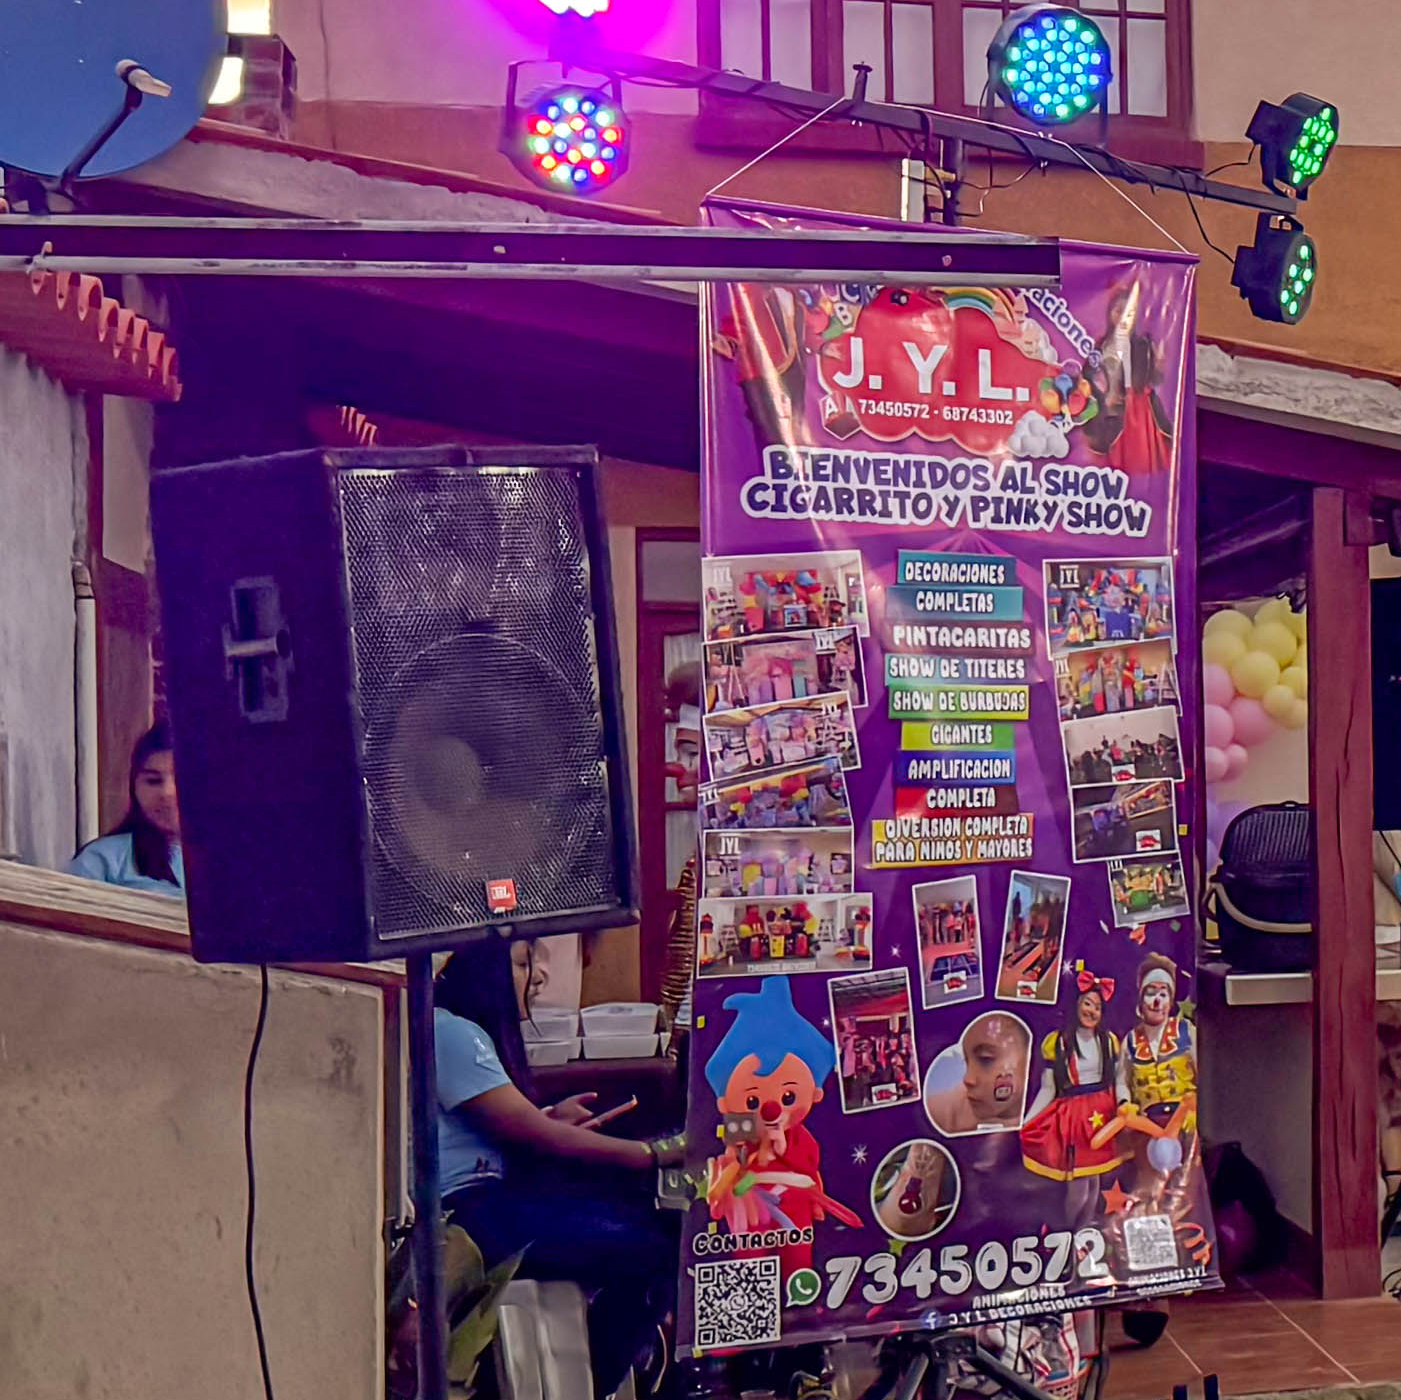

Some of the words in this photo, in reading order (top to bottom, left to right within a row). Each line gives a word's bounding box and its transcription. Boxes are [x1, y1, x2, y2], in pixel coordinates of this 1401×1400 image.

[833, 337, 882, 389] J.
[903, 341, 956, 396] Y.
[978, 348, 1030, 402] L.
[858, 399, 930, 418] 73450572
[942, 406, 1013, 424] 68743302
[769, 450, 990, 492] BIENVENIDOS
[1000, 465, 1037, 495] AL
[1044, 468, 1124, 500] SHOW
[746, 482, 934, 518] CIGARRITO
[942, 495, 963, 519] Y
[971, 495, 1060, 526] PINKY
[1067, 501, 1147, 532] SHOW
[905, 561, 1005, 584] DECORACIONES
[915, 591, 994, 613] COMPLETAS
[893, 625, 1031, 648] PINTACARITAS
[889, 657, 935, 678] SHOW
[940, 658, 960, 678] DE
[965, 658, 1025, 679] TITERES
[893, 691, 934, 711] SHOW
[939, 692, 956, 711] DE
[960, 691, 1026, 711] BURBUJAS
[931, 725, 993, 744] GIGANTES
[908, 759, 1011, 780] AMPLIFICACION
[926, 787, 996, 809] COMPLETA
[885, 817, 962, 839] DIVERSION
[965, 815, 1028, 837] COMPLETA
[875, 841, 916, 862] PARA
[965, 840, 974, 859] Y
[977, 837, 1033, 859] MAYORES
[692, 1227, 814, 1256] CONTACTOS
[825, 1227, 1109, 1310] 73450572
[989, 1296, 1093, 1320] DECORACIONES
